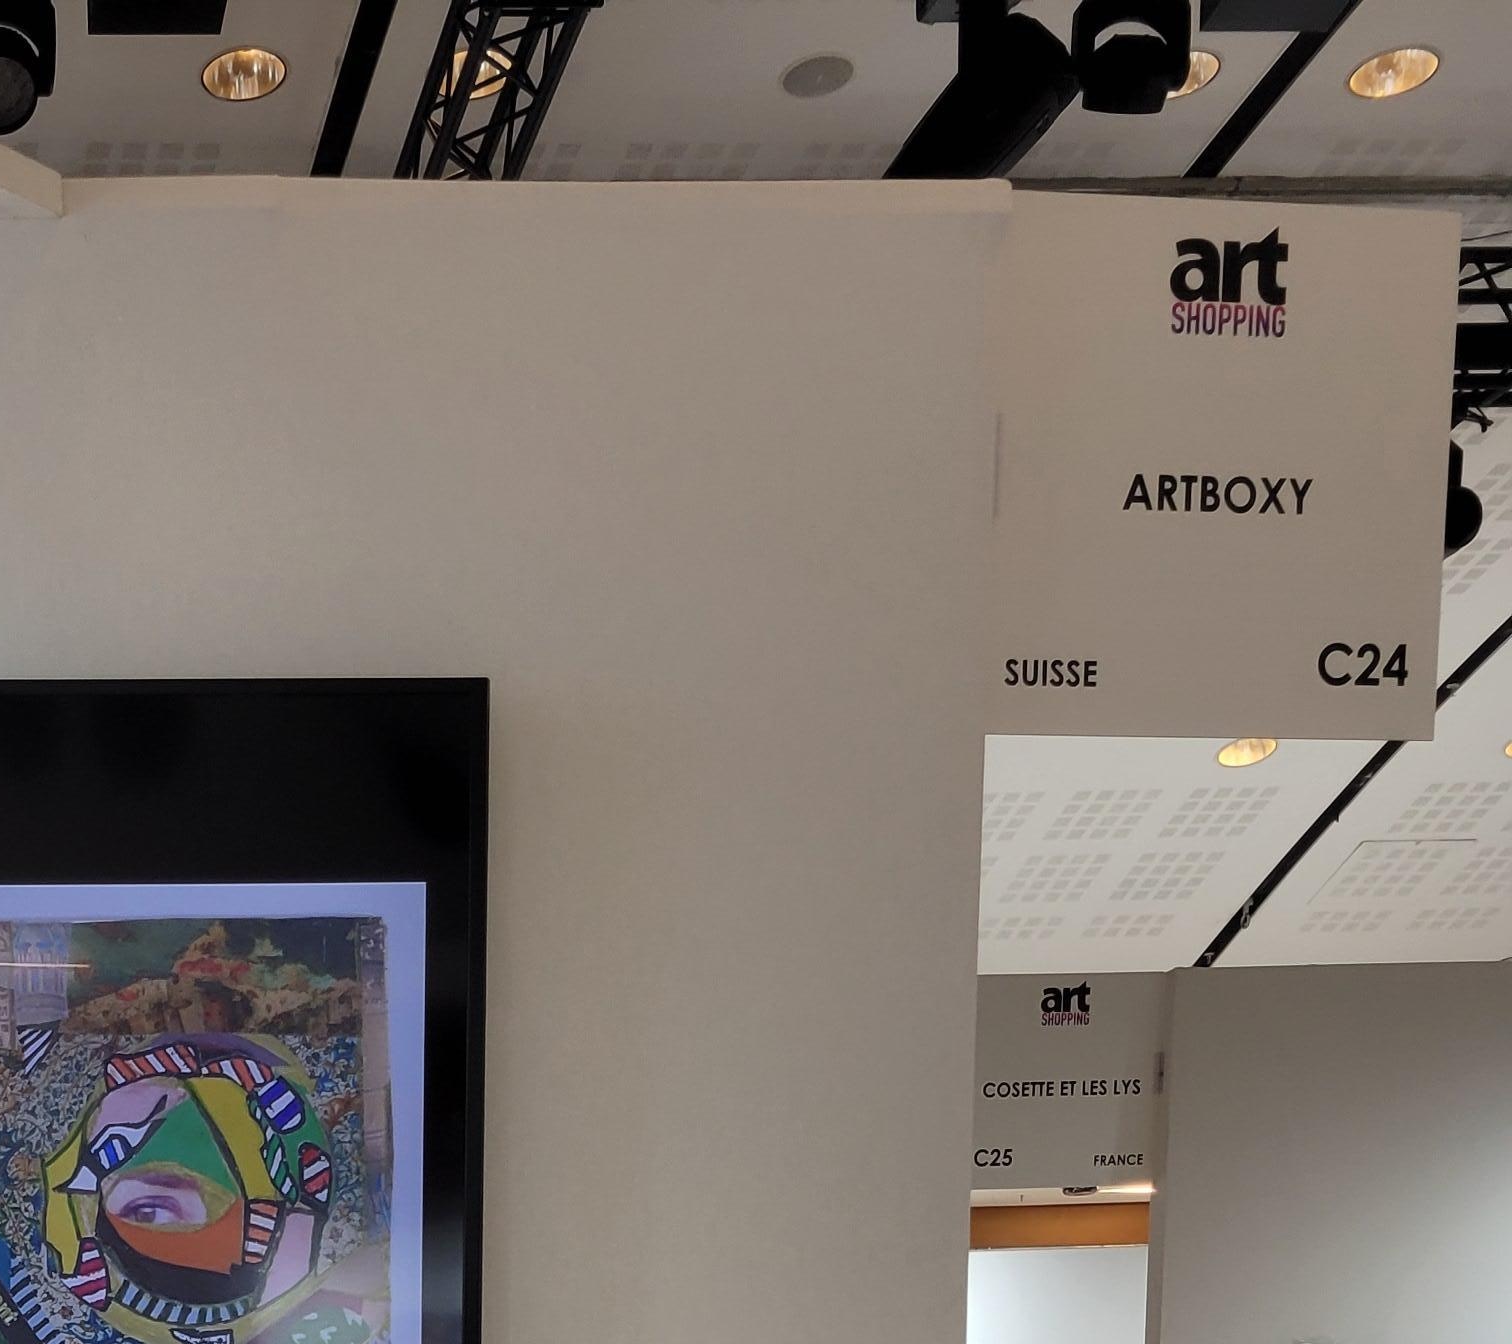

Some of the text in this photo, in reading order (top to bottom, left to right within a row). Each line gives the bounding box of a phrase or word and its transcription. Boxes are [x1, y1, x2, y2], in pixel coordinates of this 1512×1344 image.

[1170, 226, 1289, 305] art
[1171, 302, 1286, 338] SHOPPING
[1122, 473, 1313, 515] ARTBOXY
[1004, 658, 1098, 688] SUISSE
[1317, 642, 1409, 687] C24
[1040, 980, 1091, 1013] art
[1041, 1012, 1090, 1027] SHOPPING
[982, 1078, 1141, 1098] COSETTE ET LES LYS
[973, 1148, 1013, 1168] C25
[1093, 1153, 1144, 1167] FRANCE
